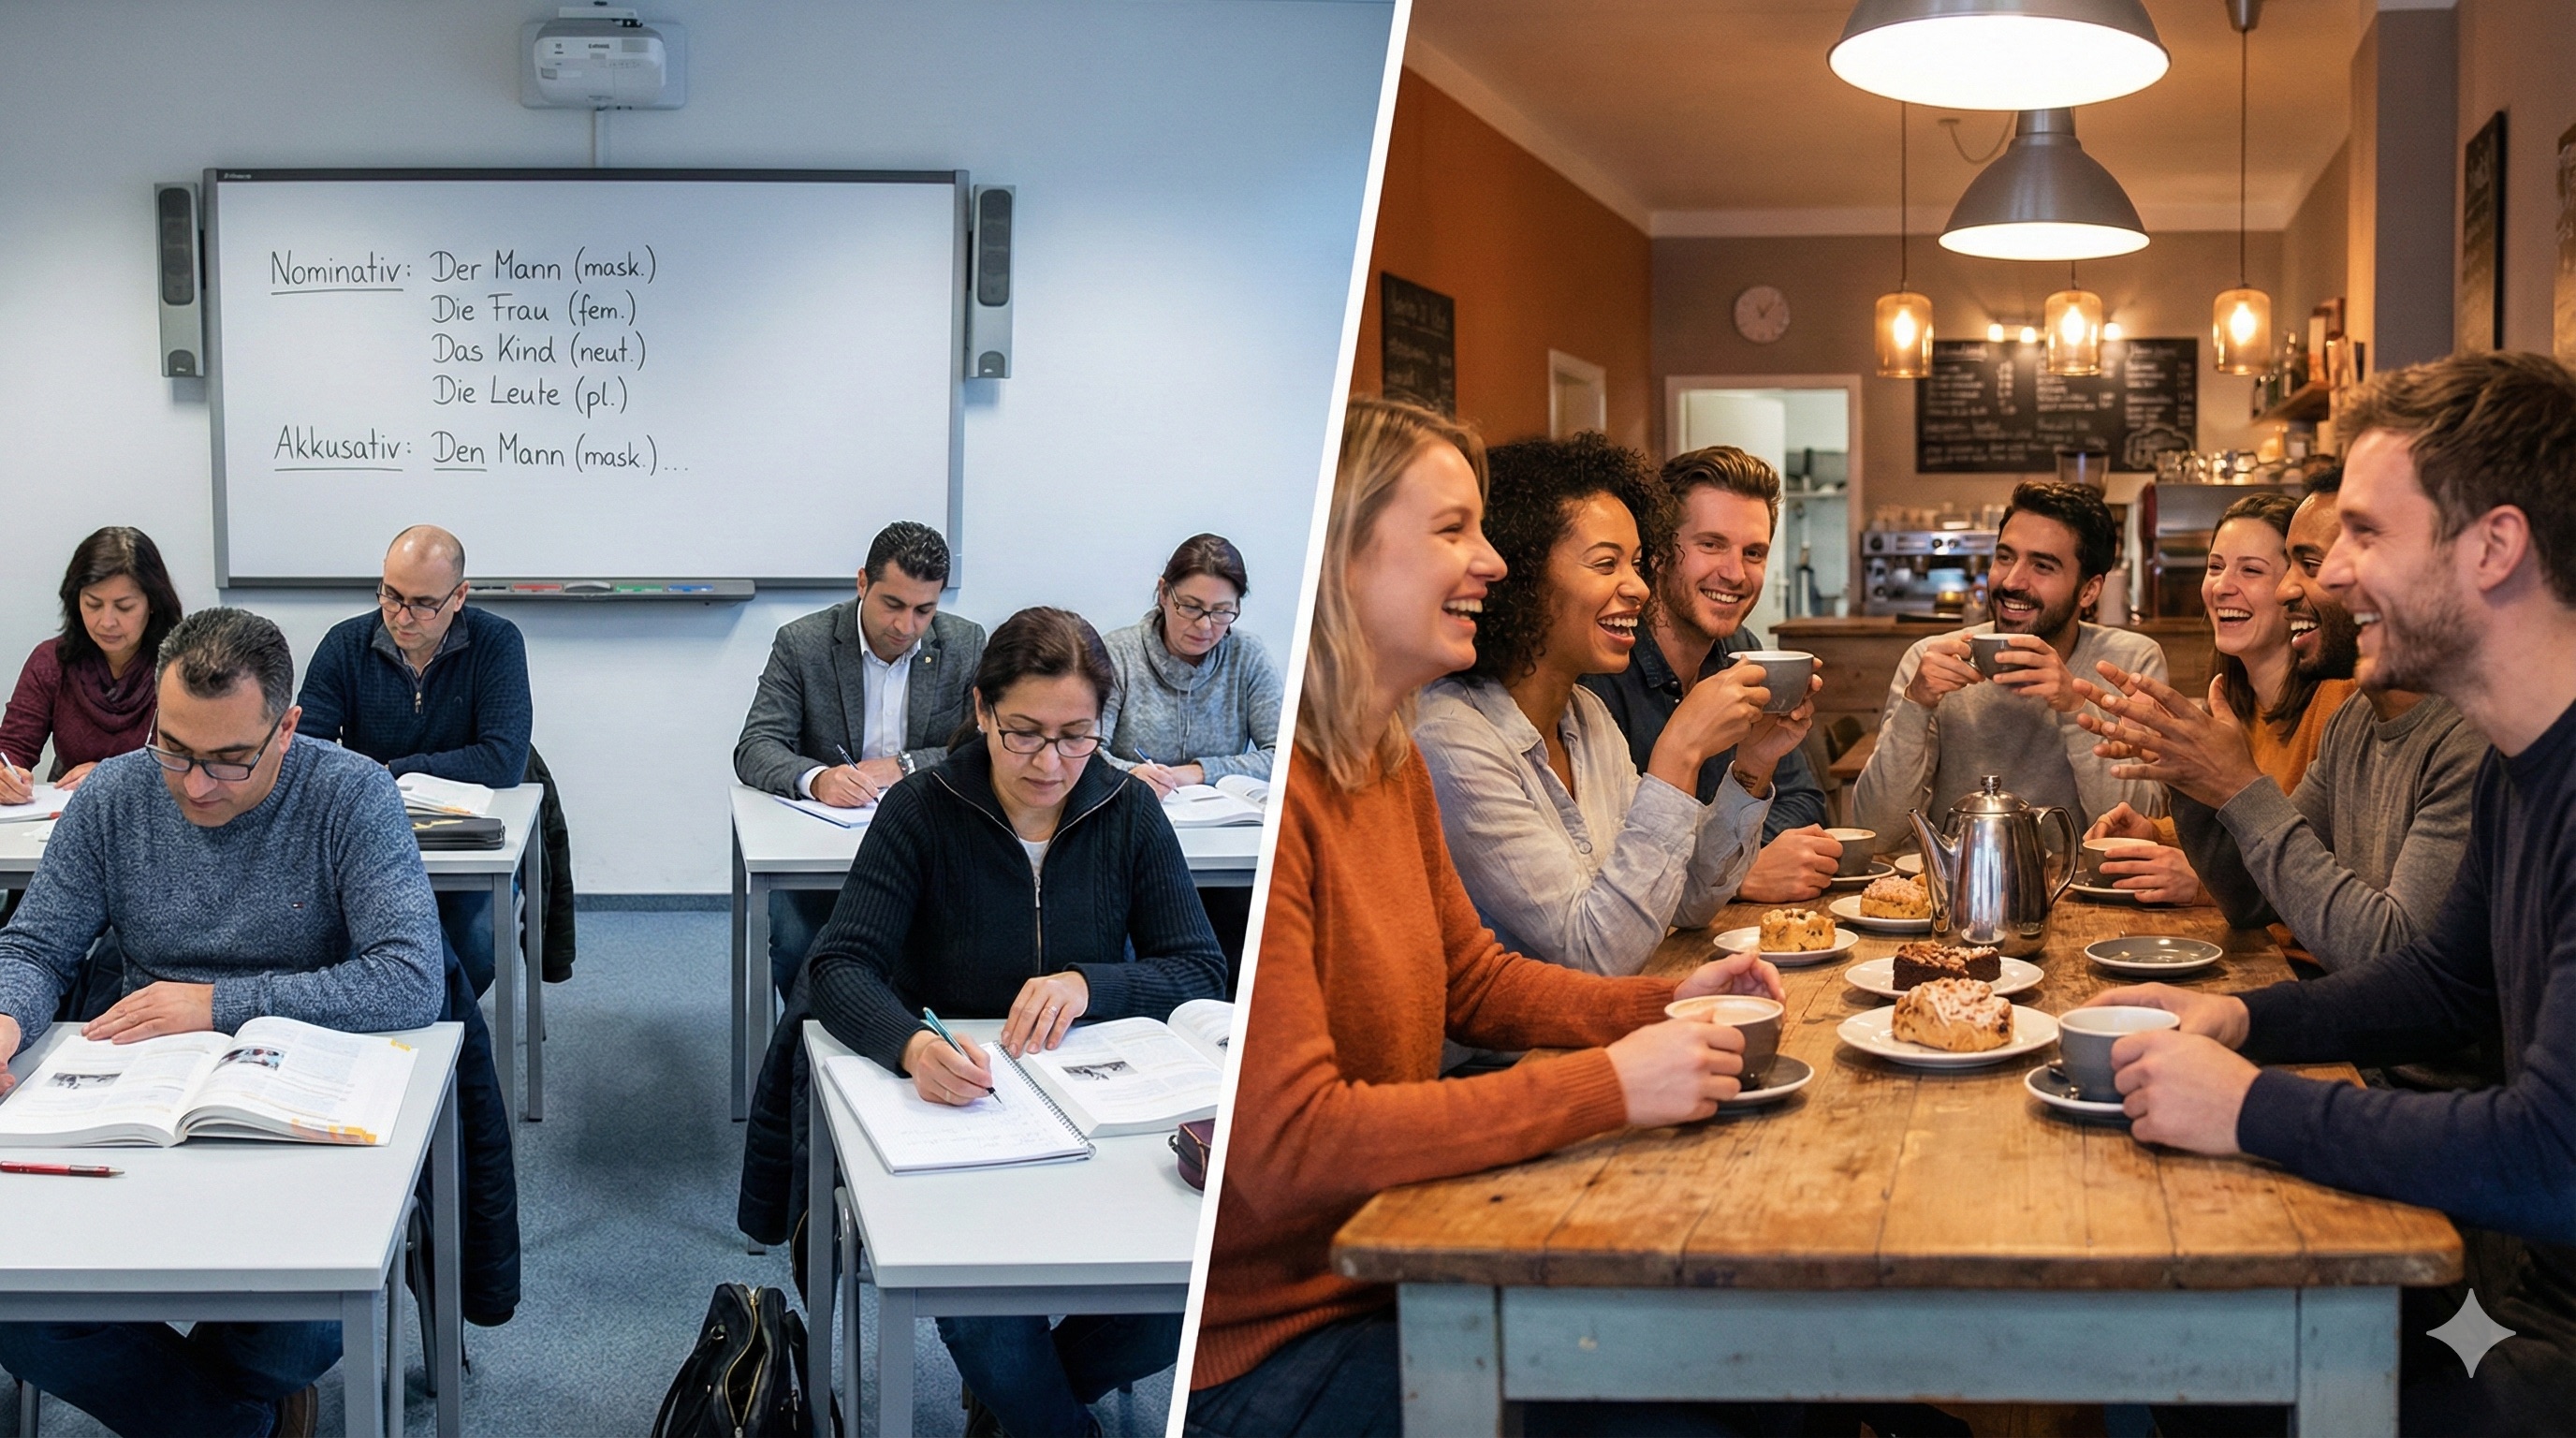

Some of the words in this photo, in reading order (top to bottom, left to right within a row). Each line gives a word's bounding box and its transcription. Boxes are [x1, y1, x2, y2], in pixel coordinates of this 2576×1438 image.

[271, 249, 411, 286] Nominativ:
[429, 250, 482, 283] Der
[494, 248, 562, 282] Mann
[574, 243, 656, 285] (mask.)
[430, 294, 476, 322] Die
[487, 292, 550, 322] Frau
[568, 289, 637, 328] (fem.)
[431, 332, 484, 364] Das
[498, 332, 557, 364] Kind
[570, 330, 646, 372] (neut.)
[432, 374, 477, 406] Die
[490, 374, 562, 406] Leute
[575, 374, 628, 419] (pl.)
[273, 424, 412, 461] Akkusativ:
[430, 430, 486, 465] Den
[499, 432, 565, 468] Mann
